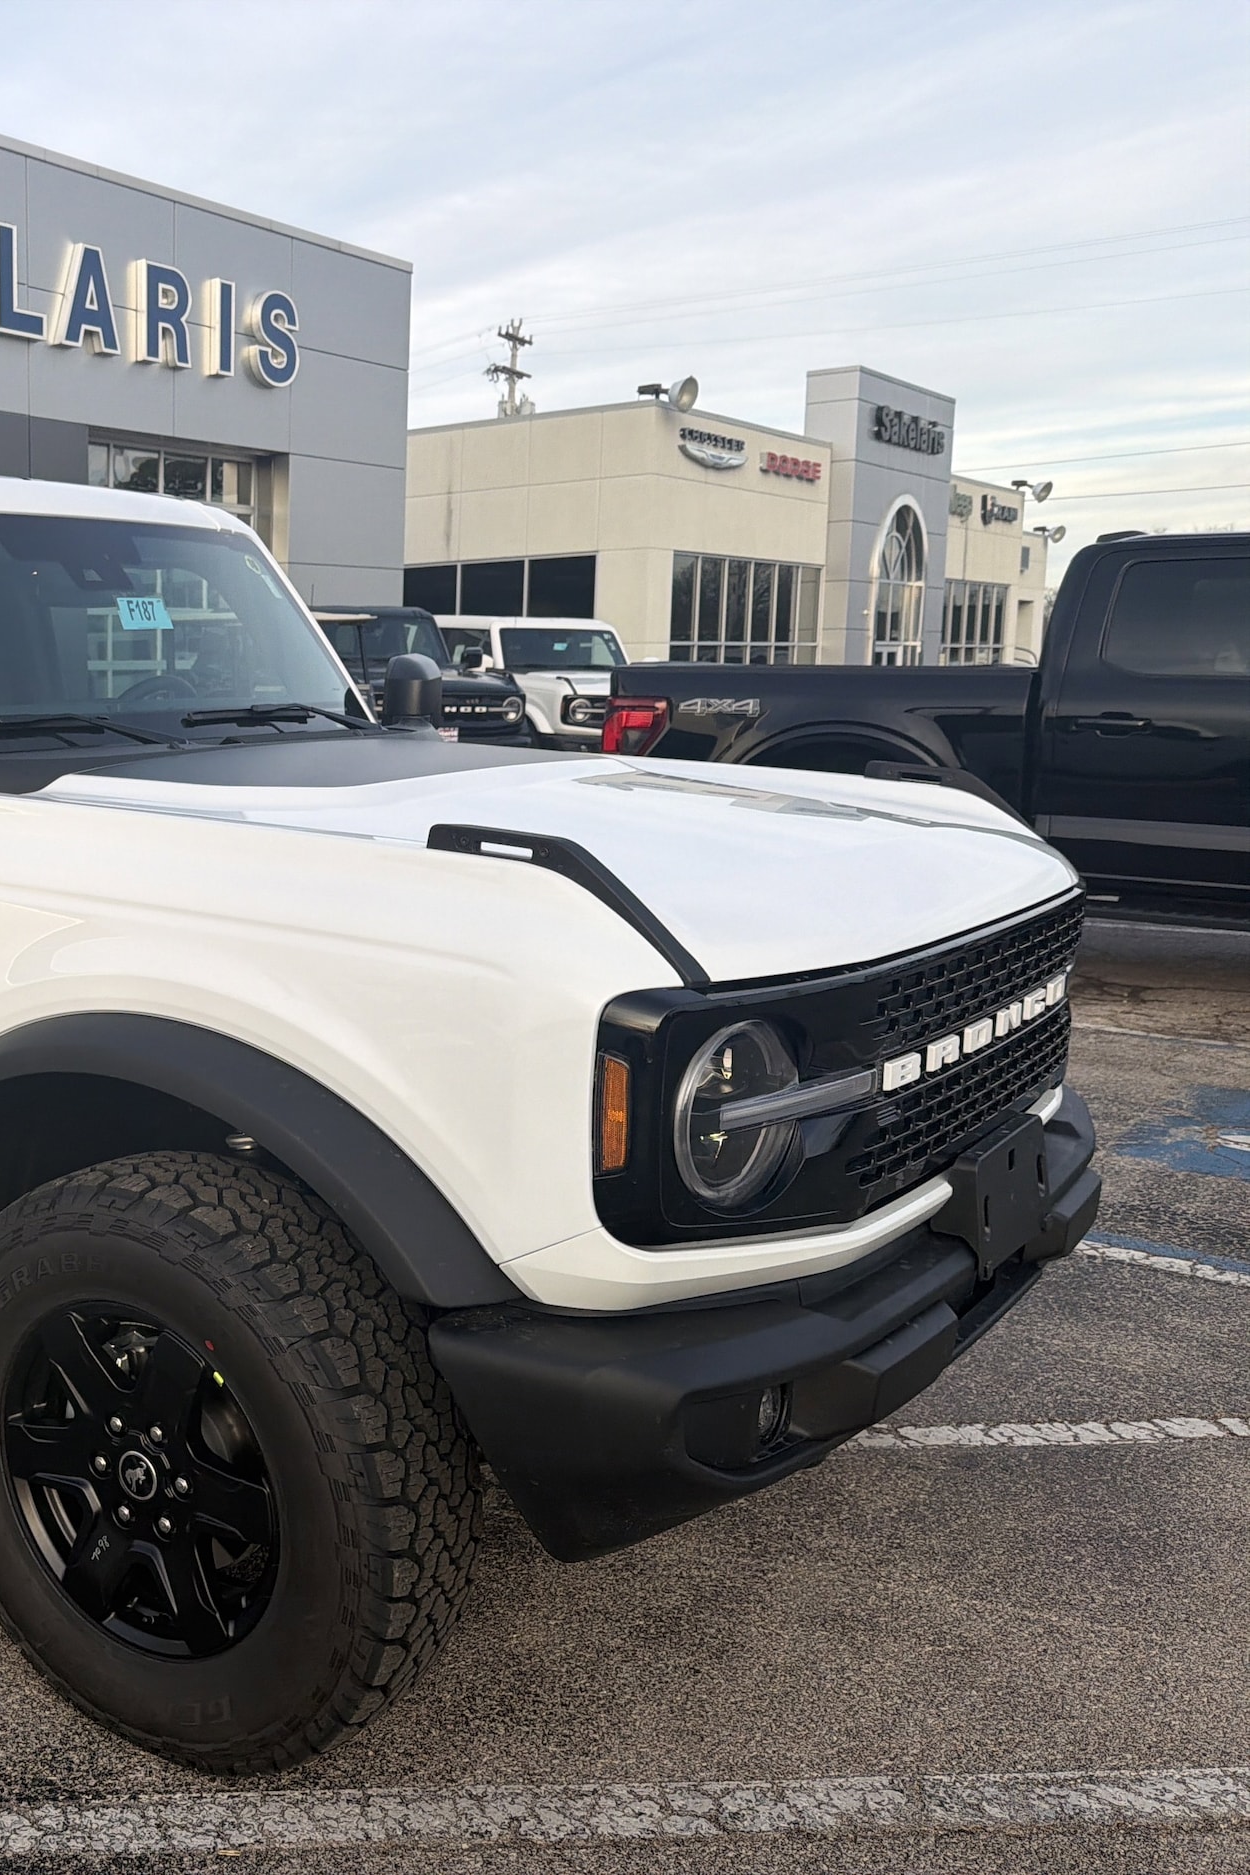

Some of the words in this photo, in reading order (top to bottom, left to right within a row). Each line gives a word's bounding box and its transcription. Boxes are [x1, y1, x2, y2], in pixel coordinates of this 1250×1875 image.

[878, 405, 945, 454] Sakelaris
[763, 451, 822, 480] DODGE
[126, 600, 156, 621] F187
[882, 974, 1067, 1092] BRONCO
